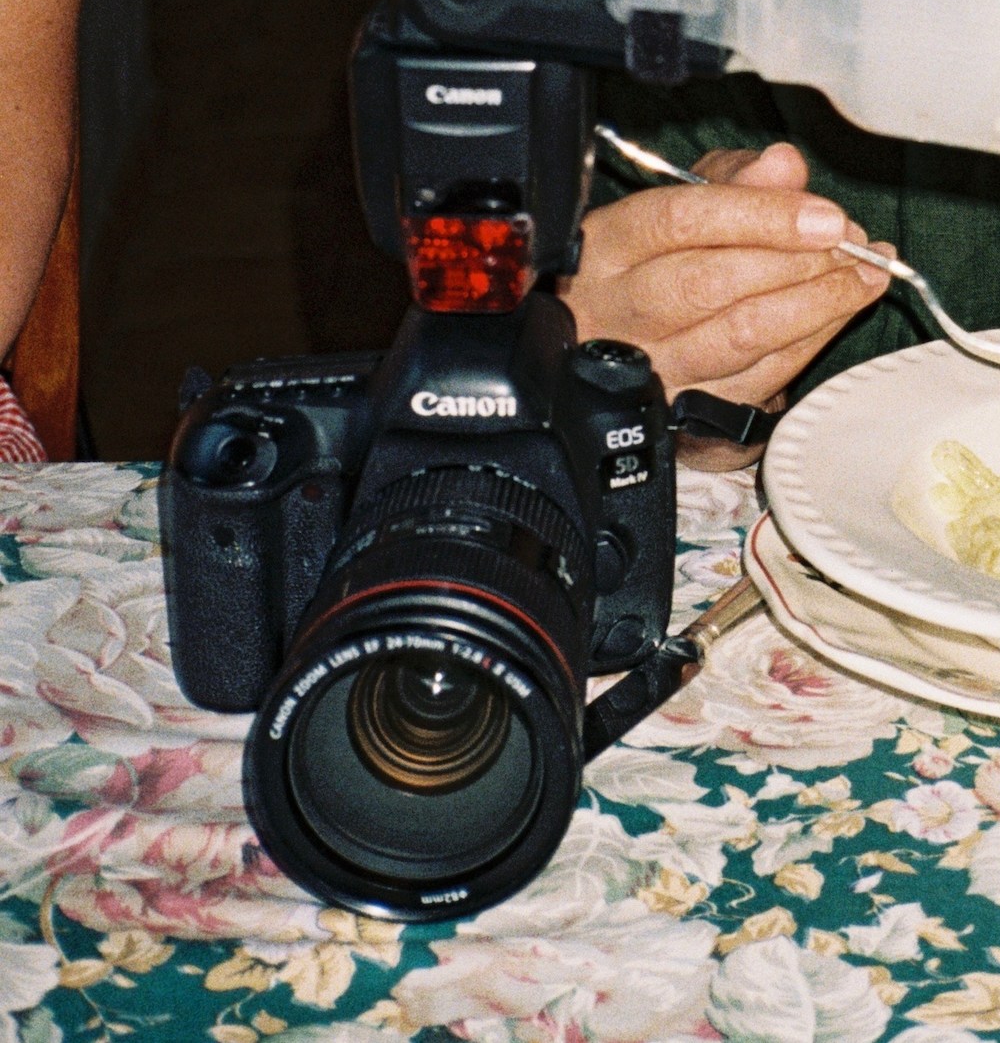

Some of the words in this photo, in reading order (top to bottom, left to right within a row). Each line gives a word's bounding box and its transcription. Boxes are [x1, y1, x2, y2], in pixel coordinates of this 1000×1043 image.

[425, 84, 502, 106] Canon
[411, 391, 517, 417] Canon
[606, 425, 645, 449] EOS
[615, 456, 639, 475] 5D
[269, 697, 297, 740] CANON
[293, 663, 328, 697] ZOOM
[328, 645, 360, 668] LENS
